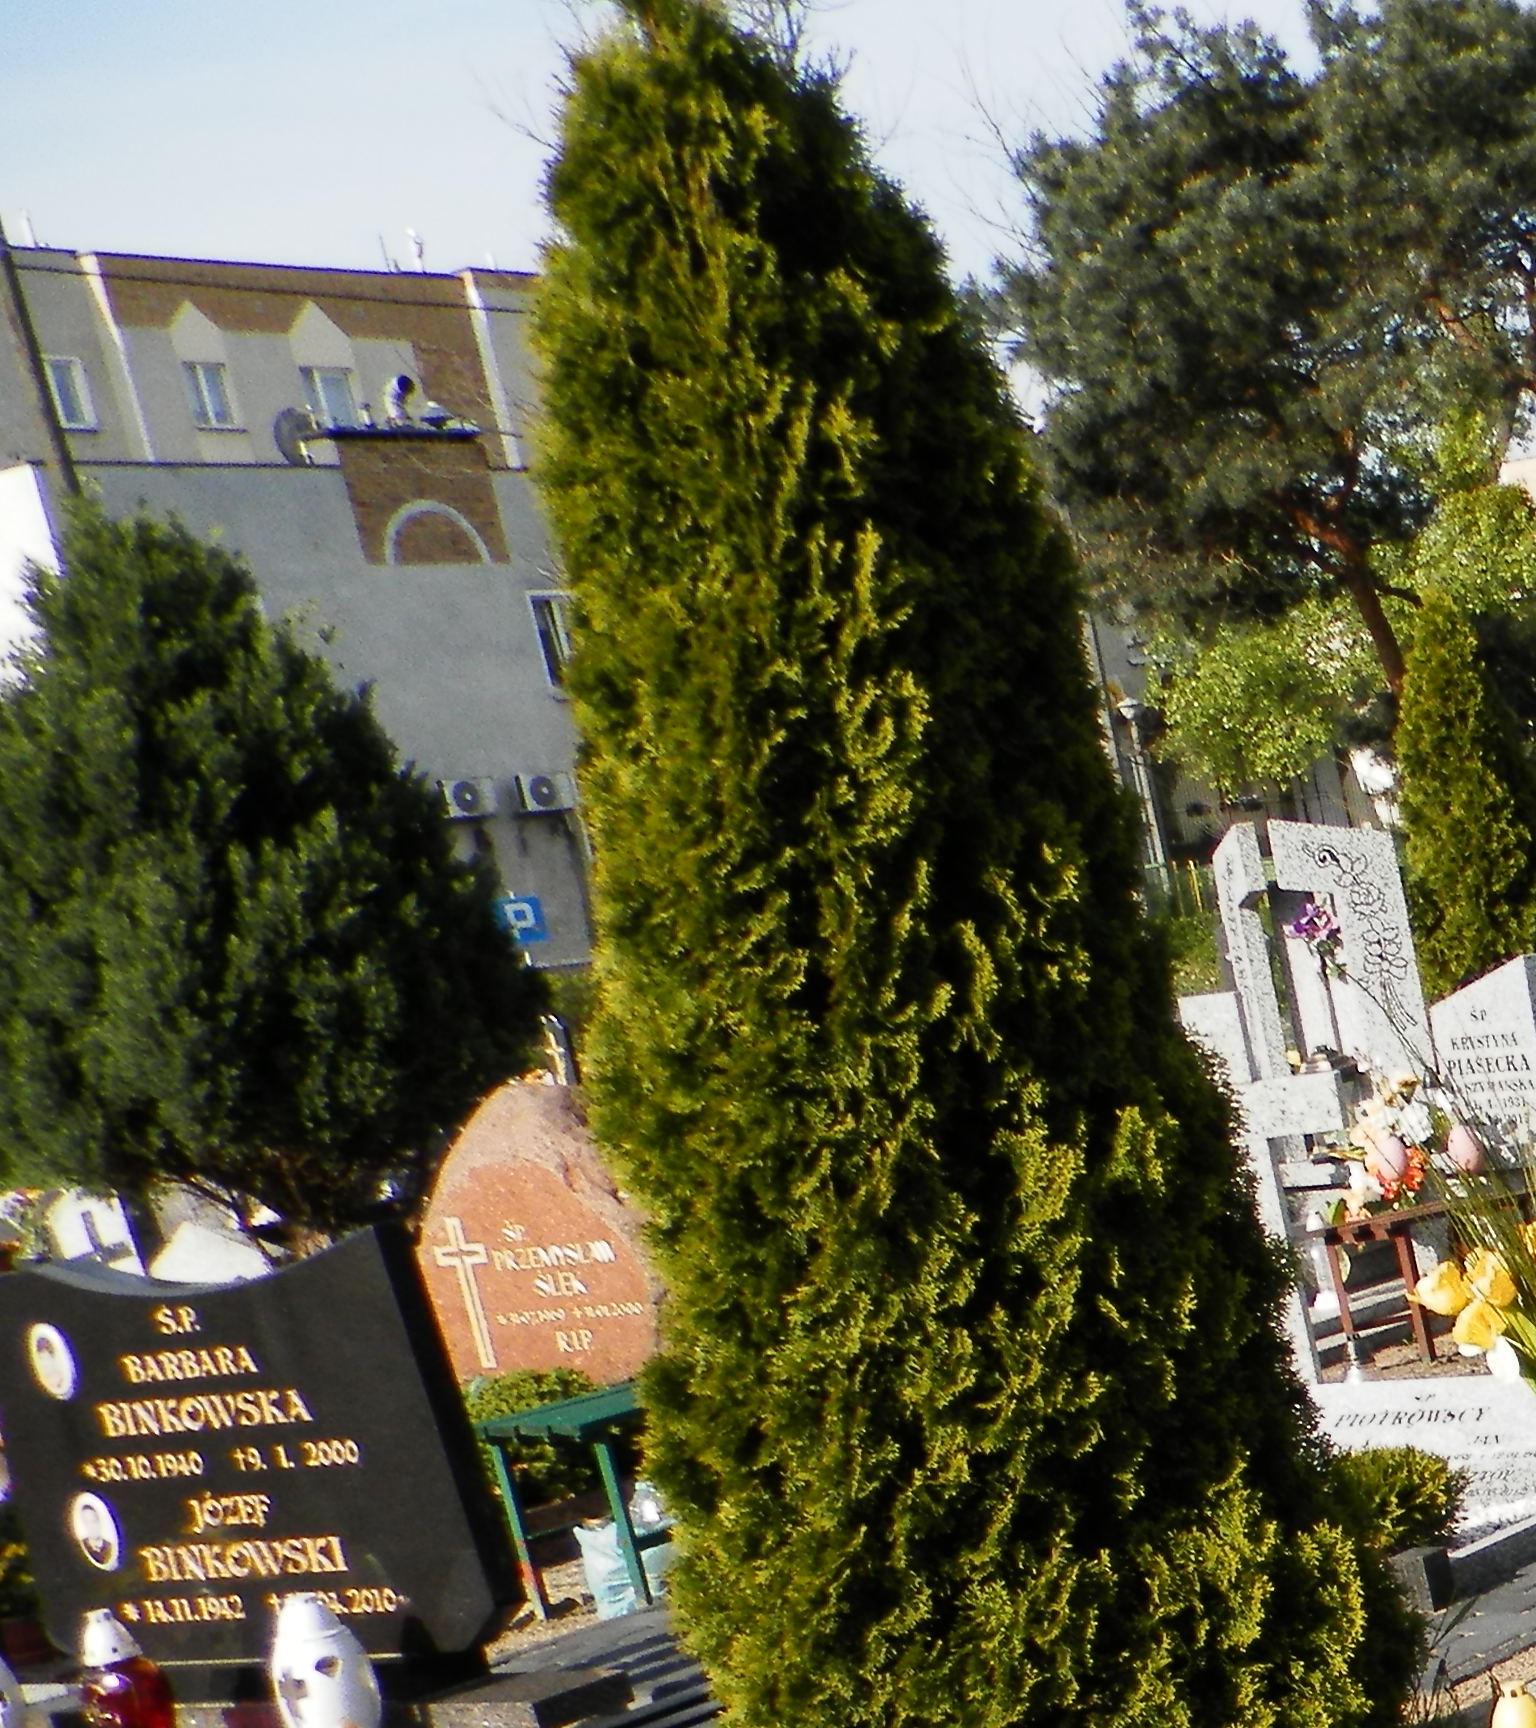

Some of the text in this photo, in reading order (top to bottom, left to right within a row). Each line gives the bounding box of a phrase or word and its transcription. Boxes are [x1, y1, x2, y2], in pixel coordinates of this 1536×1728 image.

[120, 1345, 259, 1384] BARBARA
[97, 1388, 314, 1438] BINKOWSKA
[302, 1437, 360, 1468] 2000
[187, 1490, 271, 1535] JÓZEF
[138, 1534, 350, 1583] BINKOWSKI
